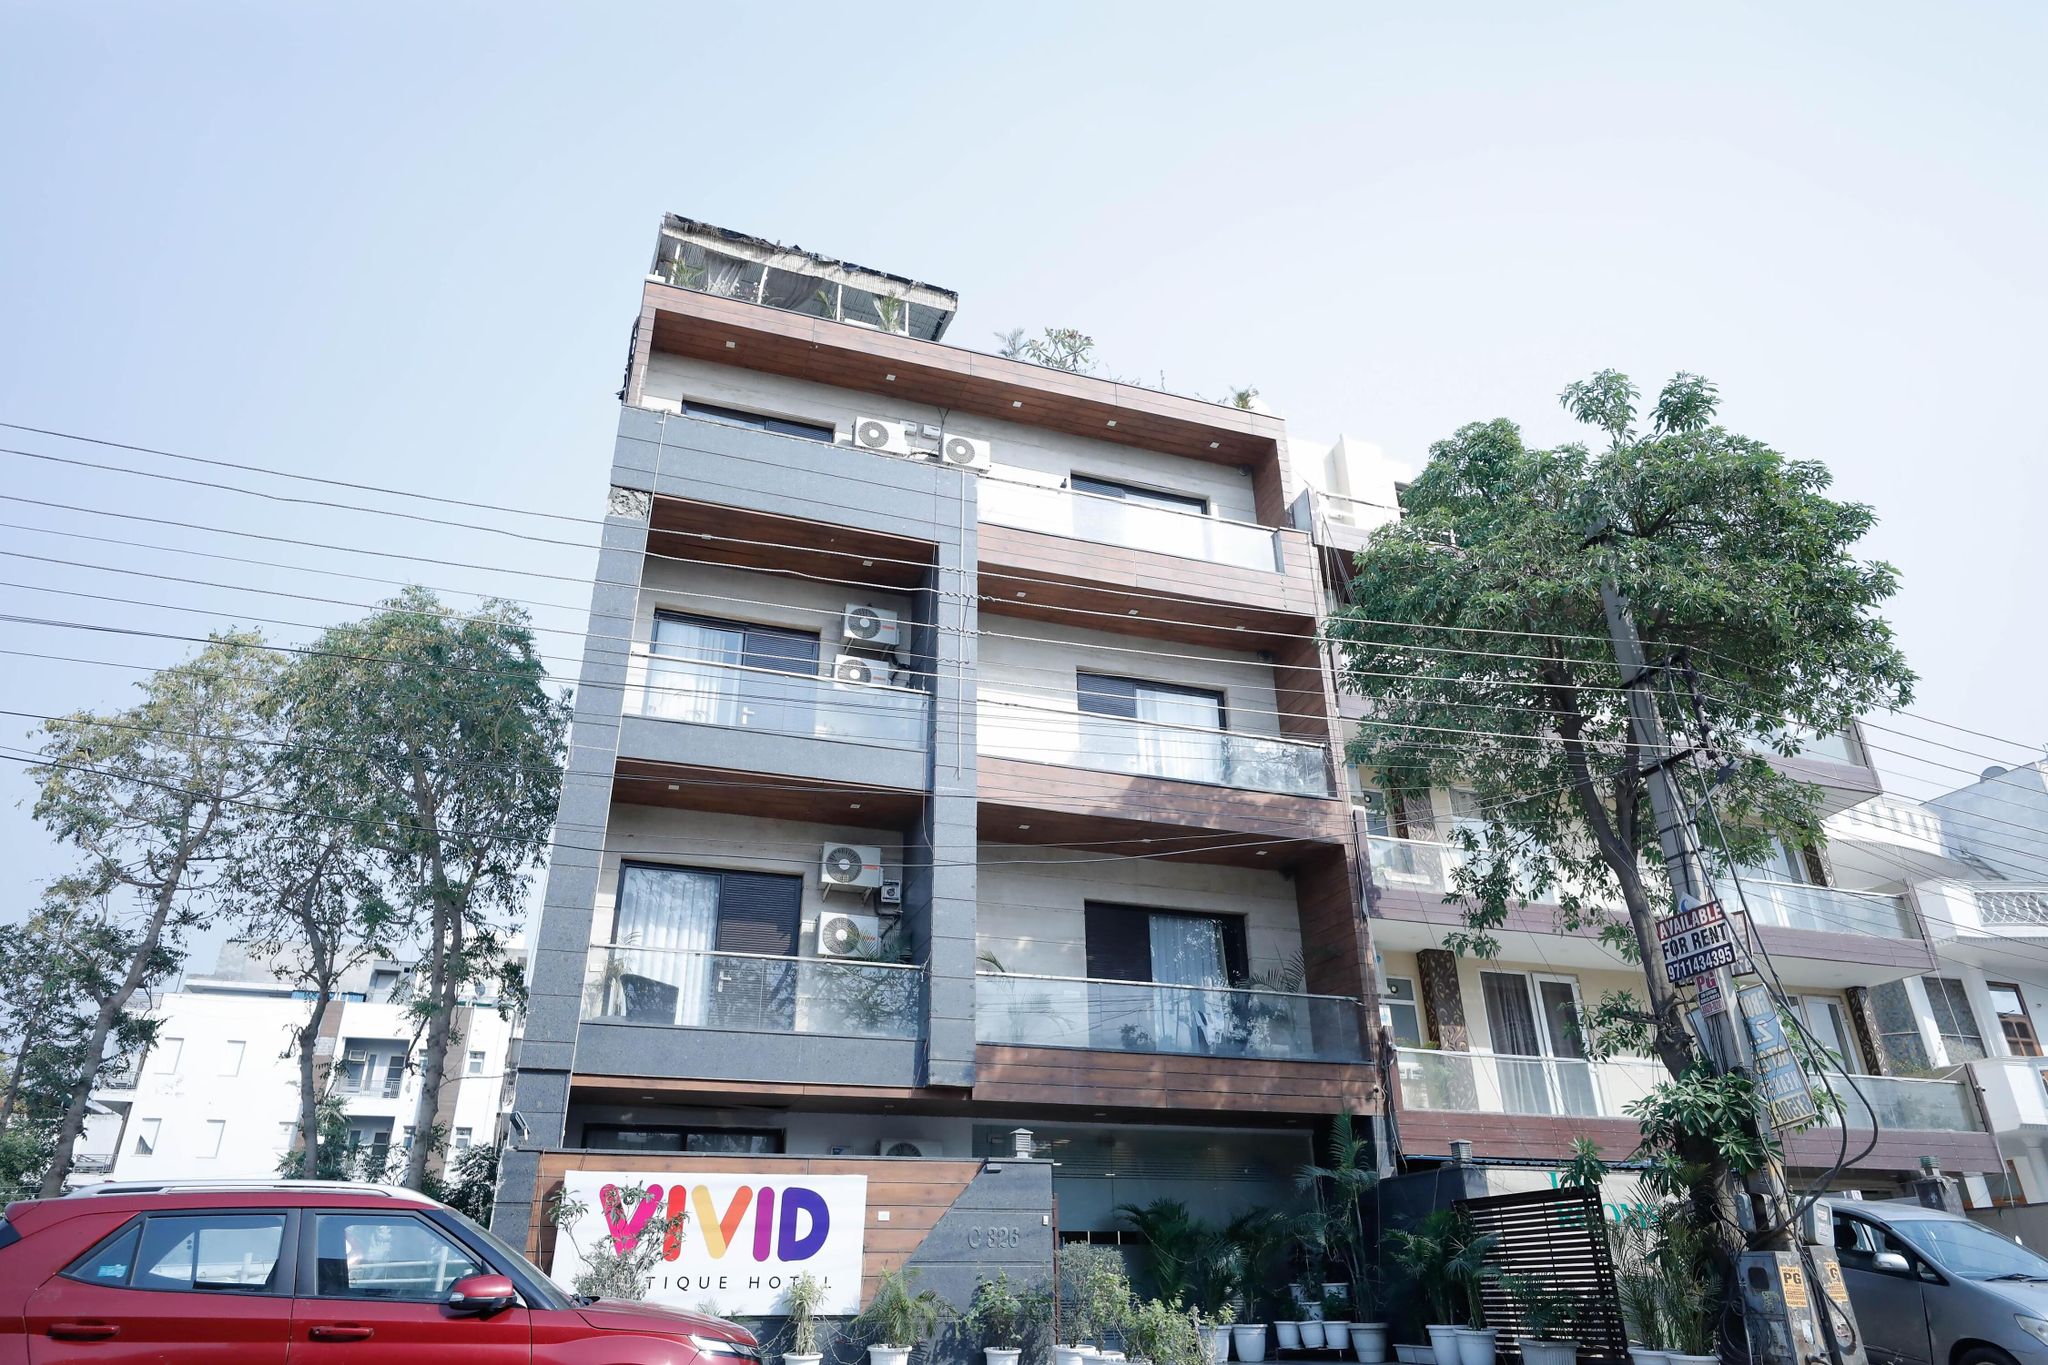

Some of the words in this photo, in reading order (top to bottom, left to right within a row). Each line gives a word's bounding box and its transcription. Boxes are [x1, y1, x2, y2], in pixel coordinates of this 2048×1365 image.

[1659, 903, 1723, 940] AVAILABLE
[1662, 937, 1689, 960] FOR
[1691, 922, 1727, 950] RENT
[1668, 946, 1733, 980] 9711434395
[600, 1183, 830, 1262] VIVID
[645, 1276, 728, 1290] TIQUE
[748, 1276, 832, 1290] HOTL
[1783, 1272, 1802, 1284] PG
